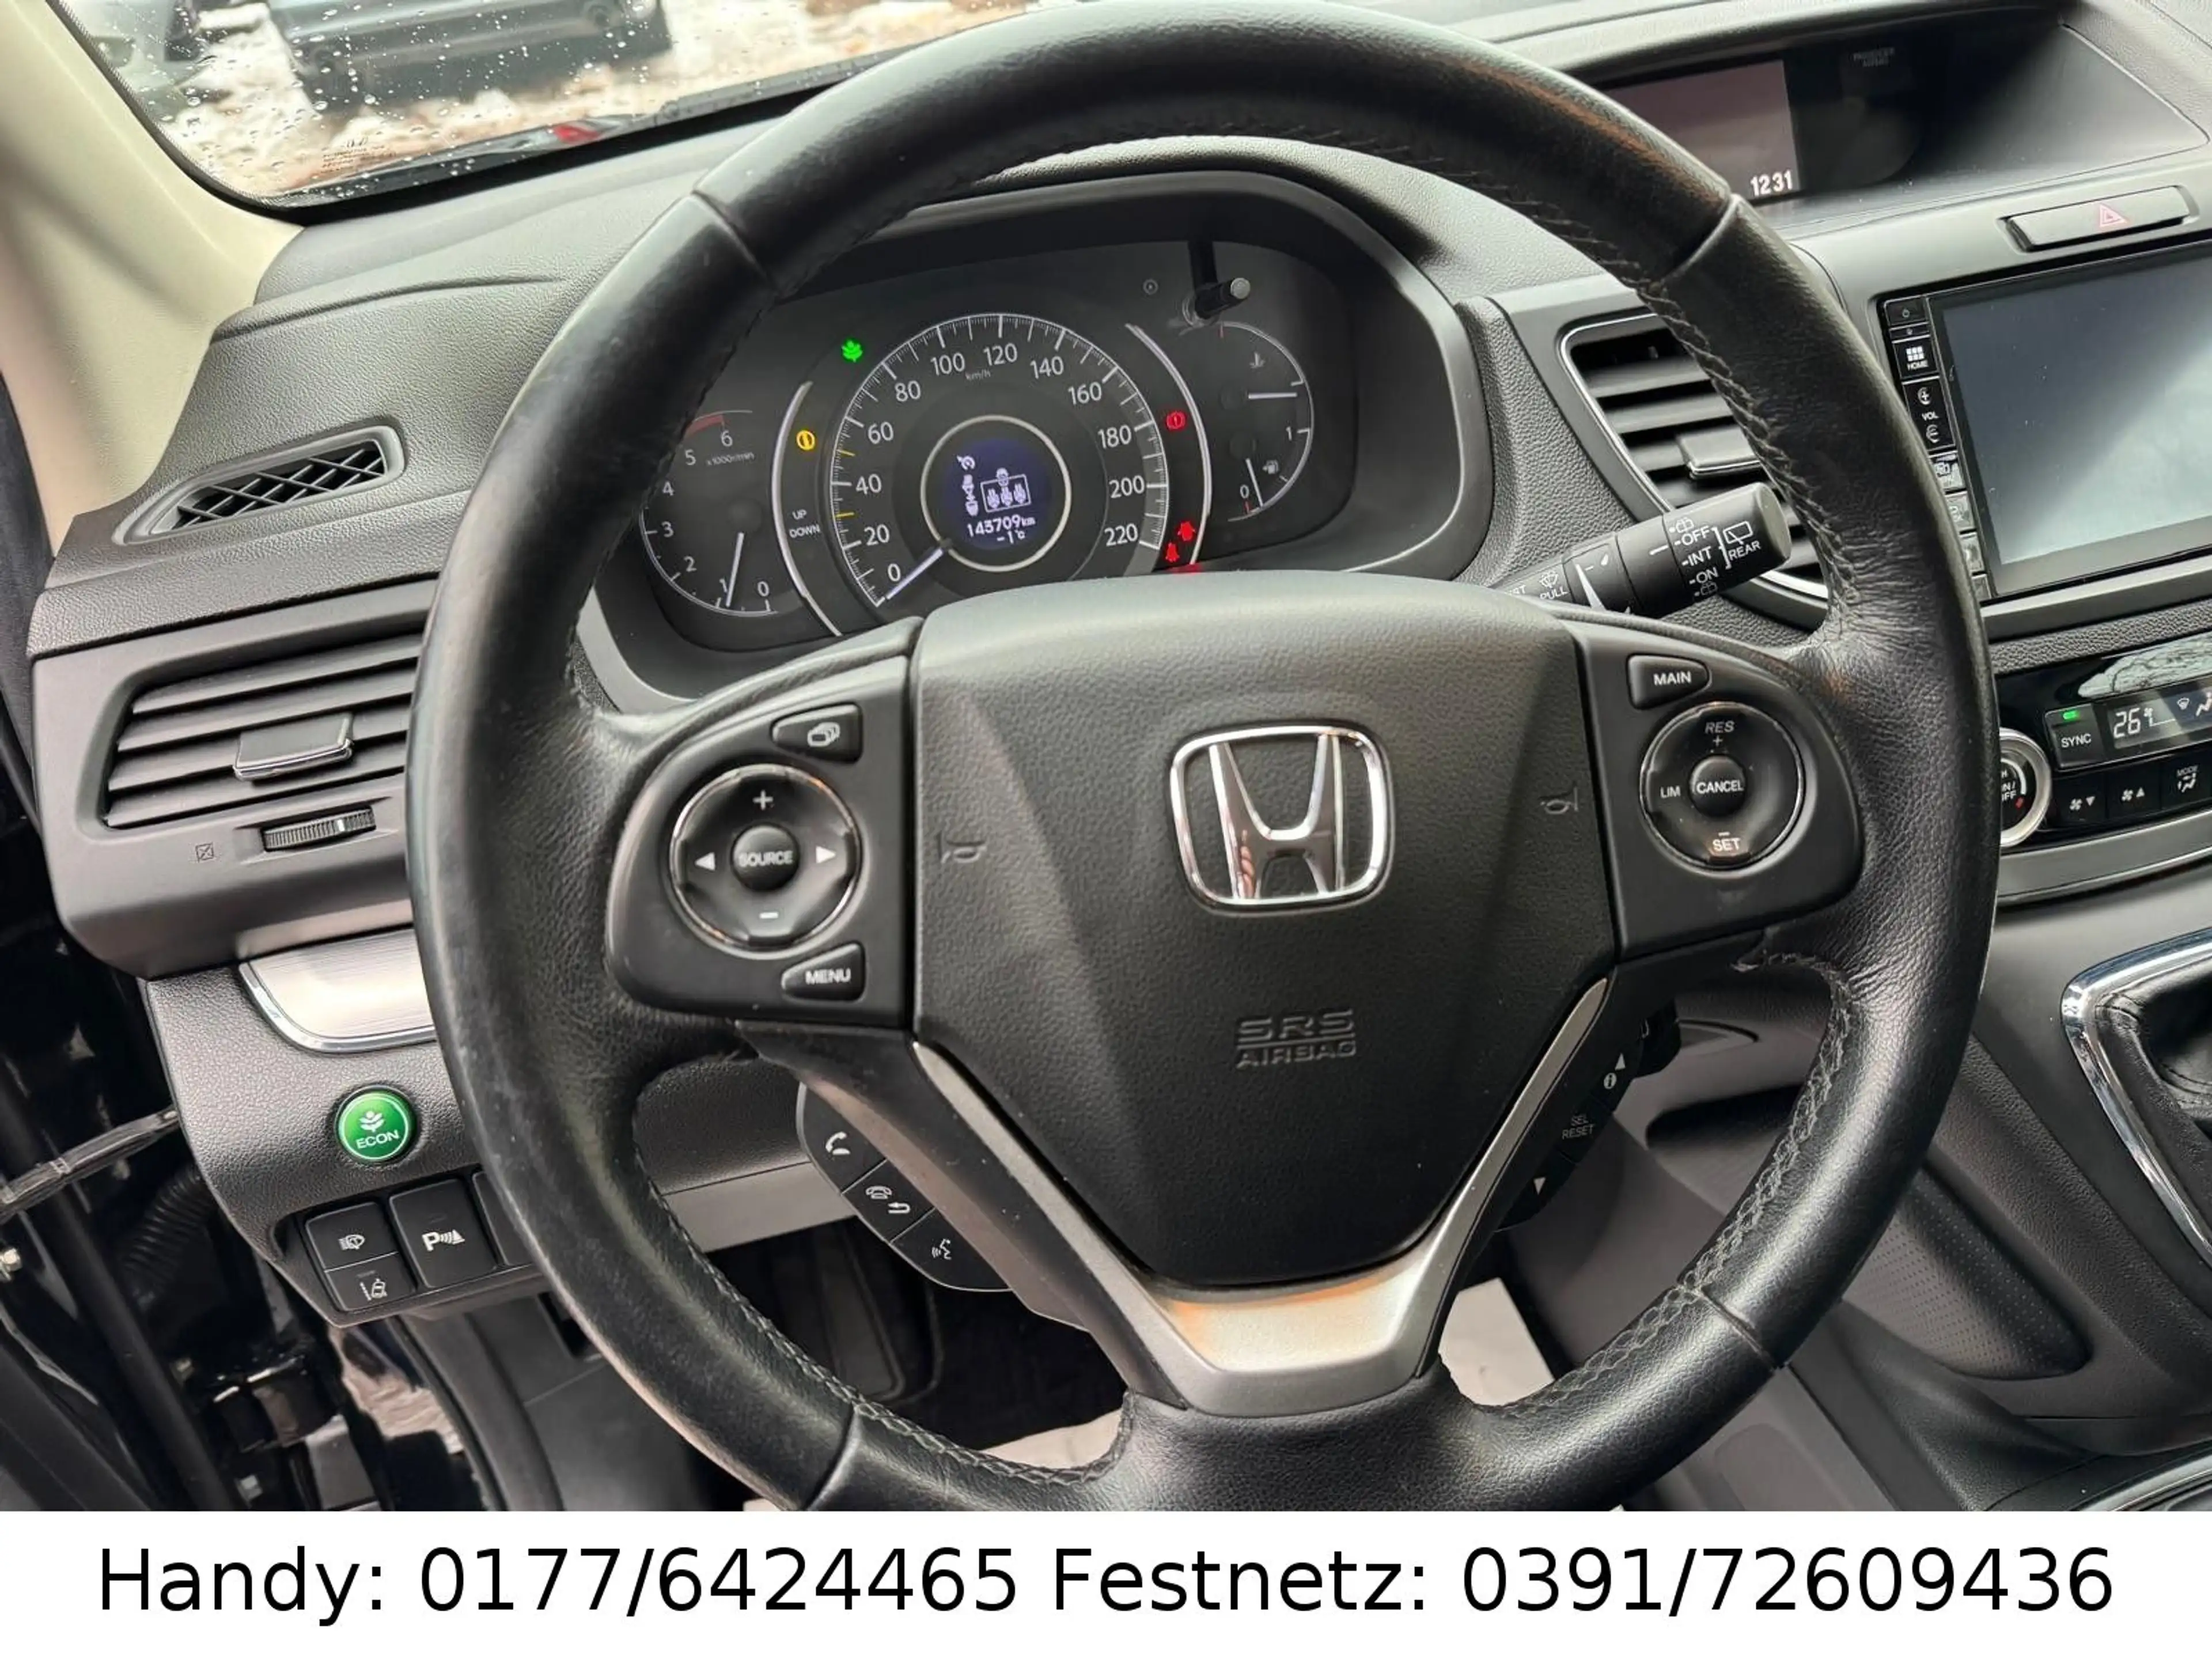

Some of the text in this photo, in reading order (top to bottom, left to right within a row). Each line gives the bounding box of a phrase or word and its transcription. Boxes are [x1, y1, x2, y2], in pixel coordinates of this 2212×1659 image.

[1750, 170, 1793, 196] 1231
[983, 343, 1017, 366] 120
[930, 352, 965, 376] 100
[1030, 356, 1064, 378] 140
[965, 369, 991, 380] km/h
[895, 380, 921, 402] 80
[1068, 382, 1102, 405] 160
[1922, 411, 1939, 421] VOL
[721, 430, 733, 447] 6
[868, 422, 894, 443] 60
[1099, 425, 1131, 448] 180
[1286, 426, 1292, 440] 1
[684, 449, 696, 465] 5
[662, 482, 673, 496] 4
[856, 474, 882, 495] 40
[1109, 475, 1145, 499] 200
[1240, 485, 1249, 499] 0
[792, 509, 807, 520] UP
[662, 522, 673, 537] 3
[789, 524, 820, 539] DOWN
[866, 525, 891, 545] 20
[1104, 524, 1139, 547] 220
[1681, 525, 1710, 545] OFF
[1688, 546, 1711, 566] INT
[1730, 540, 1761, 560] REAR
[684, 556, 696, 572] 2
[888, 563, 901, 583] 0
[1696, 567, 1718, 584] ON
[719, 578, 728, 593] 1
[757, 581, 770, 597] 0
[1653, 671, 1692, 686] MAIN
[1705, 721, 1734, 733] RES
[2061, 734, 2092, 748] SYNC
[1660, 786, 1681, 798] LIM
[1696, 779, 1743, 793] CANCEL
[1713, 838, 1740, 852] SET
[738, 850, 793, 866] SOURCE
[805, 968, 851, 984] MENU
[1239, 1009, 1353, 1042] SRS
[1236, 1040, 1357, 1069] AIRBAG
[1571, 1114, 1589, 1126] SEL
[356, 1130, 399, 1149] ECON
[1562, 1124, 1594, 1140] RESET
